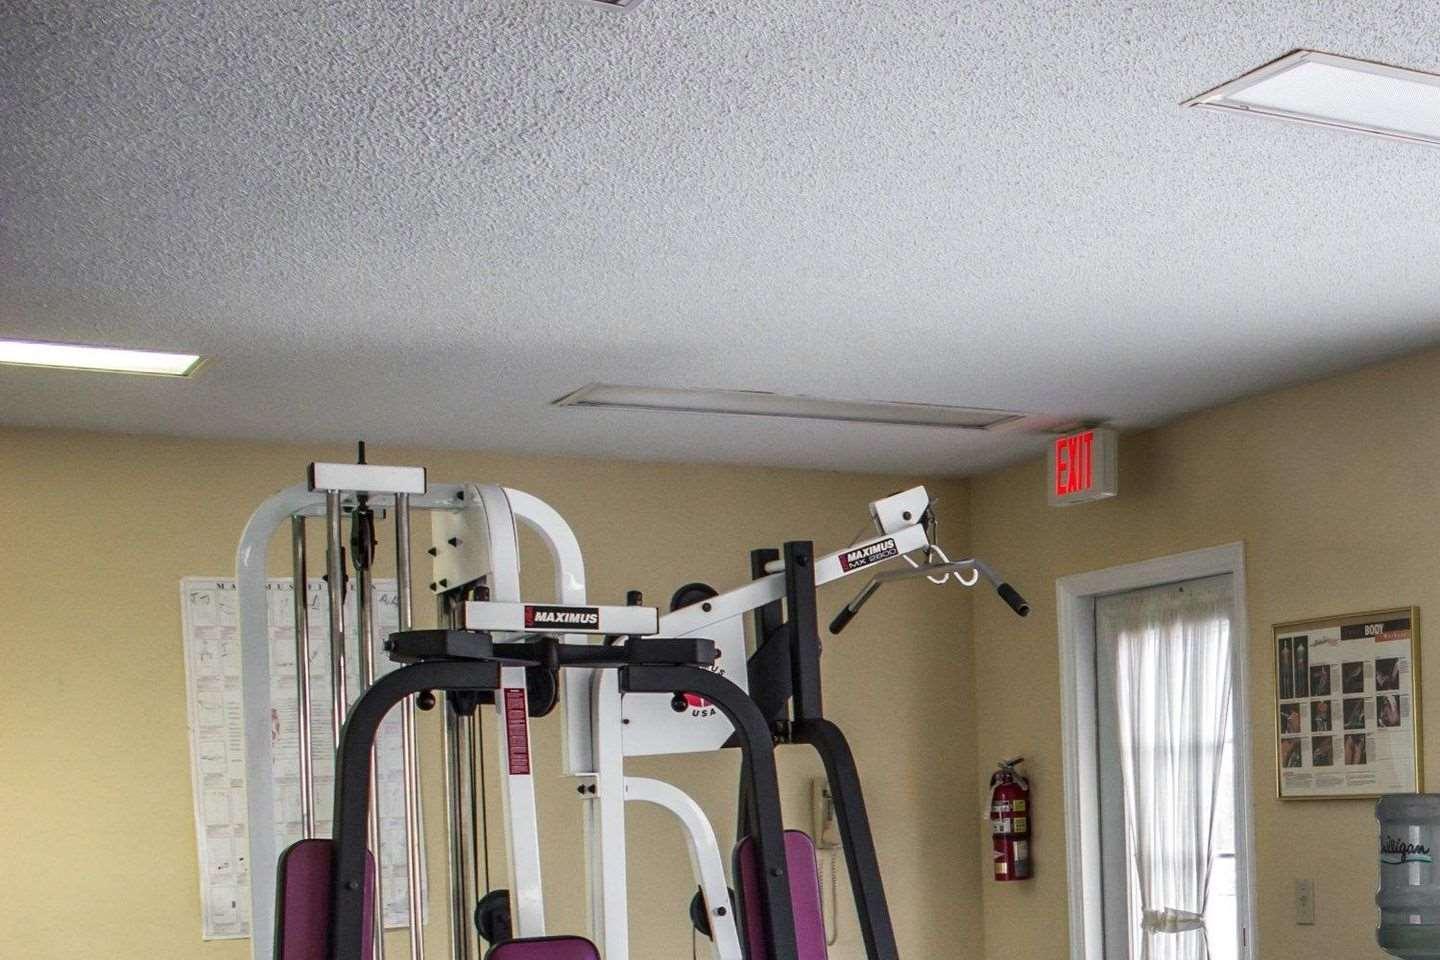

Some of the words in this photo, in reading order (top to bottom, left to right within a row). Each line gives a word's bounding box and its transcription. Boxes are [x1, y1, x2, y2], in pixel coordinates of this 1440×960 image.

[1056, 431, 1094, 496] EXIT
[847, 539, 895, 562] MAXIMUS
[534, 611, 598, 624] MAXIMUS
[692, 708, 717, 717] USA
